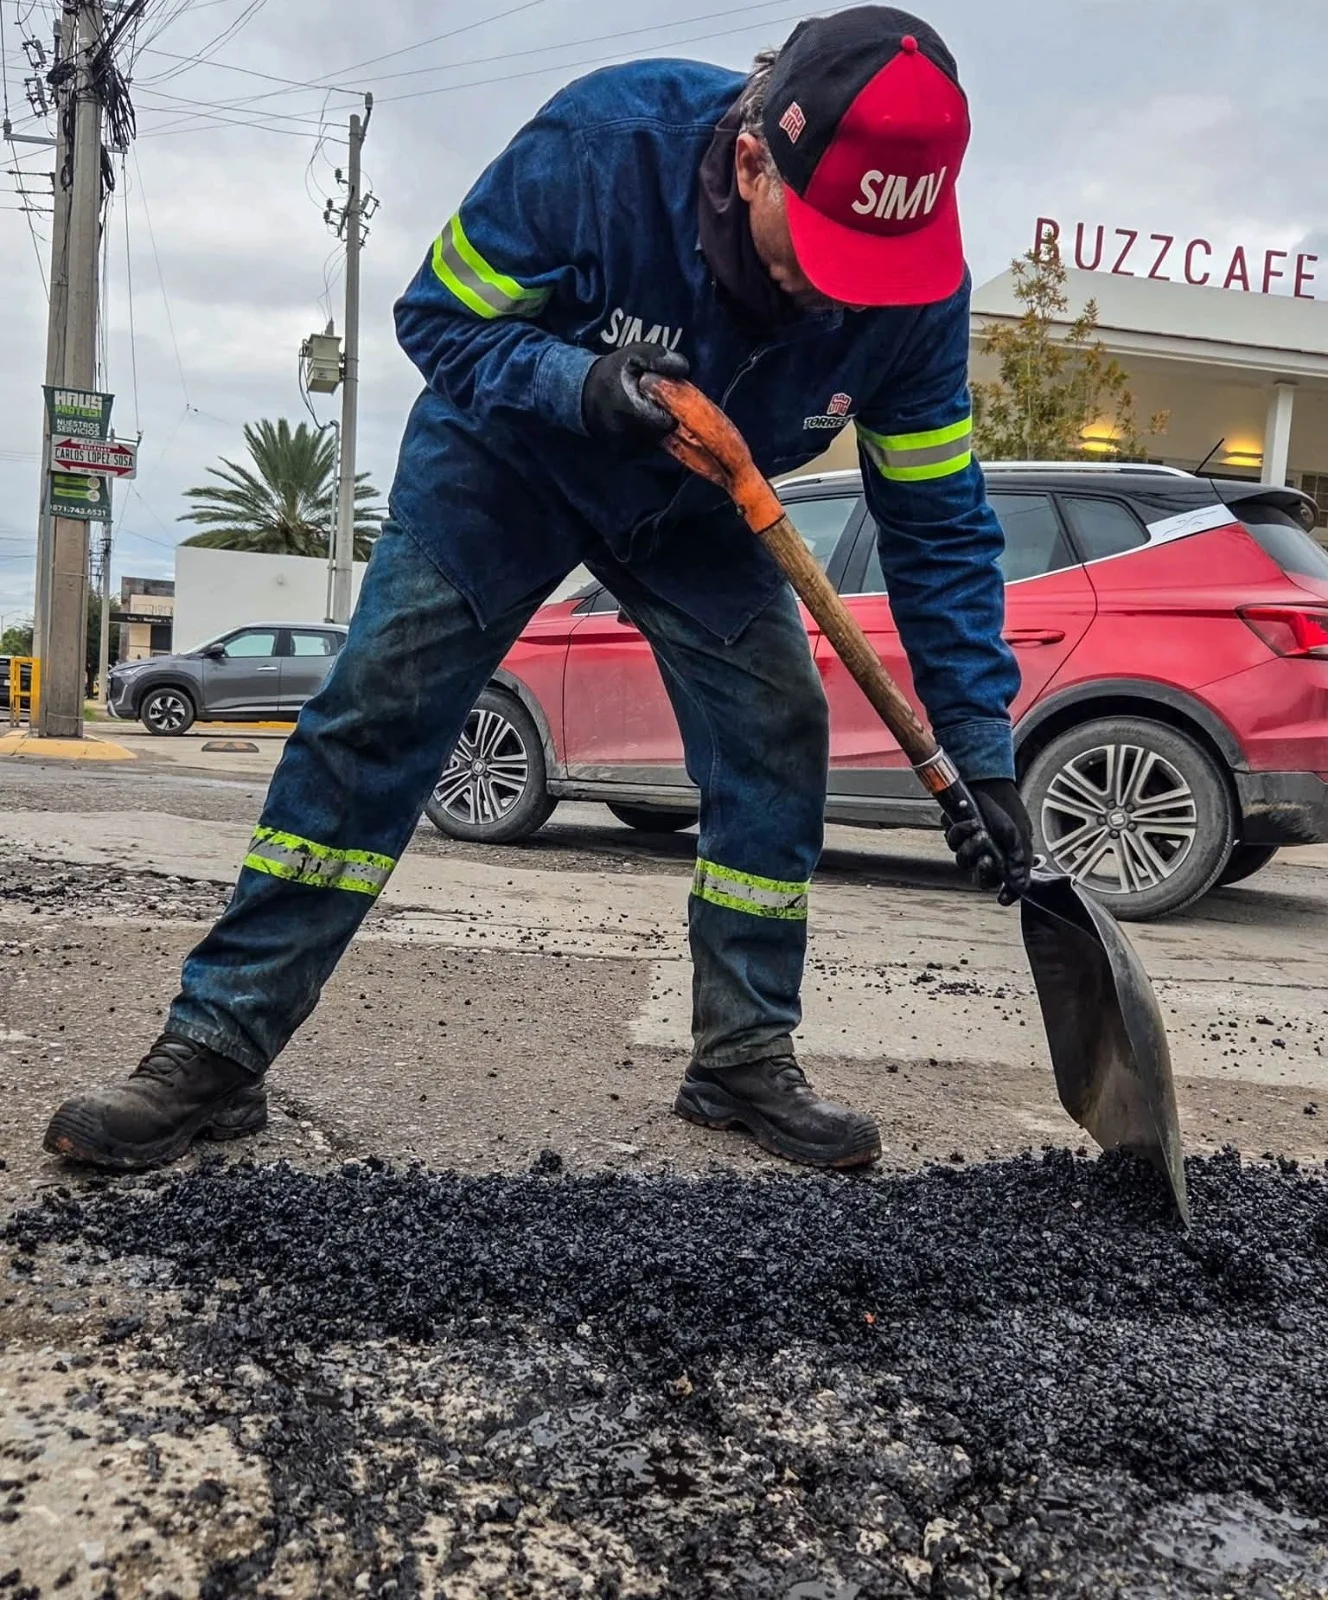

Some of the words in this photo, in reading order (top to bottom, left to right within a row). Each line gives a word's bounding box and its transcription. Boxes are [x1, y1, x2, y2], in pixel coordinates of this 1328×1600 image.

[851, 166, 947, 220] SIMV
[1034, 216, 1318, 300] BUZZCAFE
[600, 307, 683, 350] SIMV
[54, 390, 103, 411] HAUS
[56, 418, 100, 429] NUESTROS
[56, 425, 100, 436] SERVICIOS
[803, 415, 852, 430] TORRE
[55, 447, 84, 461] CARLOS
[87, 450, 110, 465] LOPEZ
[114, 454, 134, 467] SOSA
